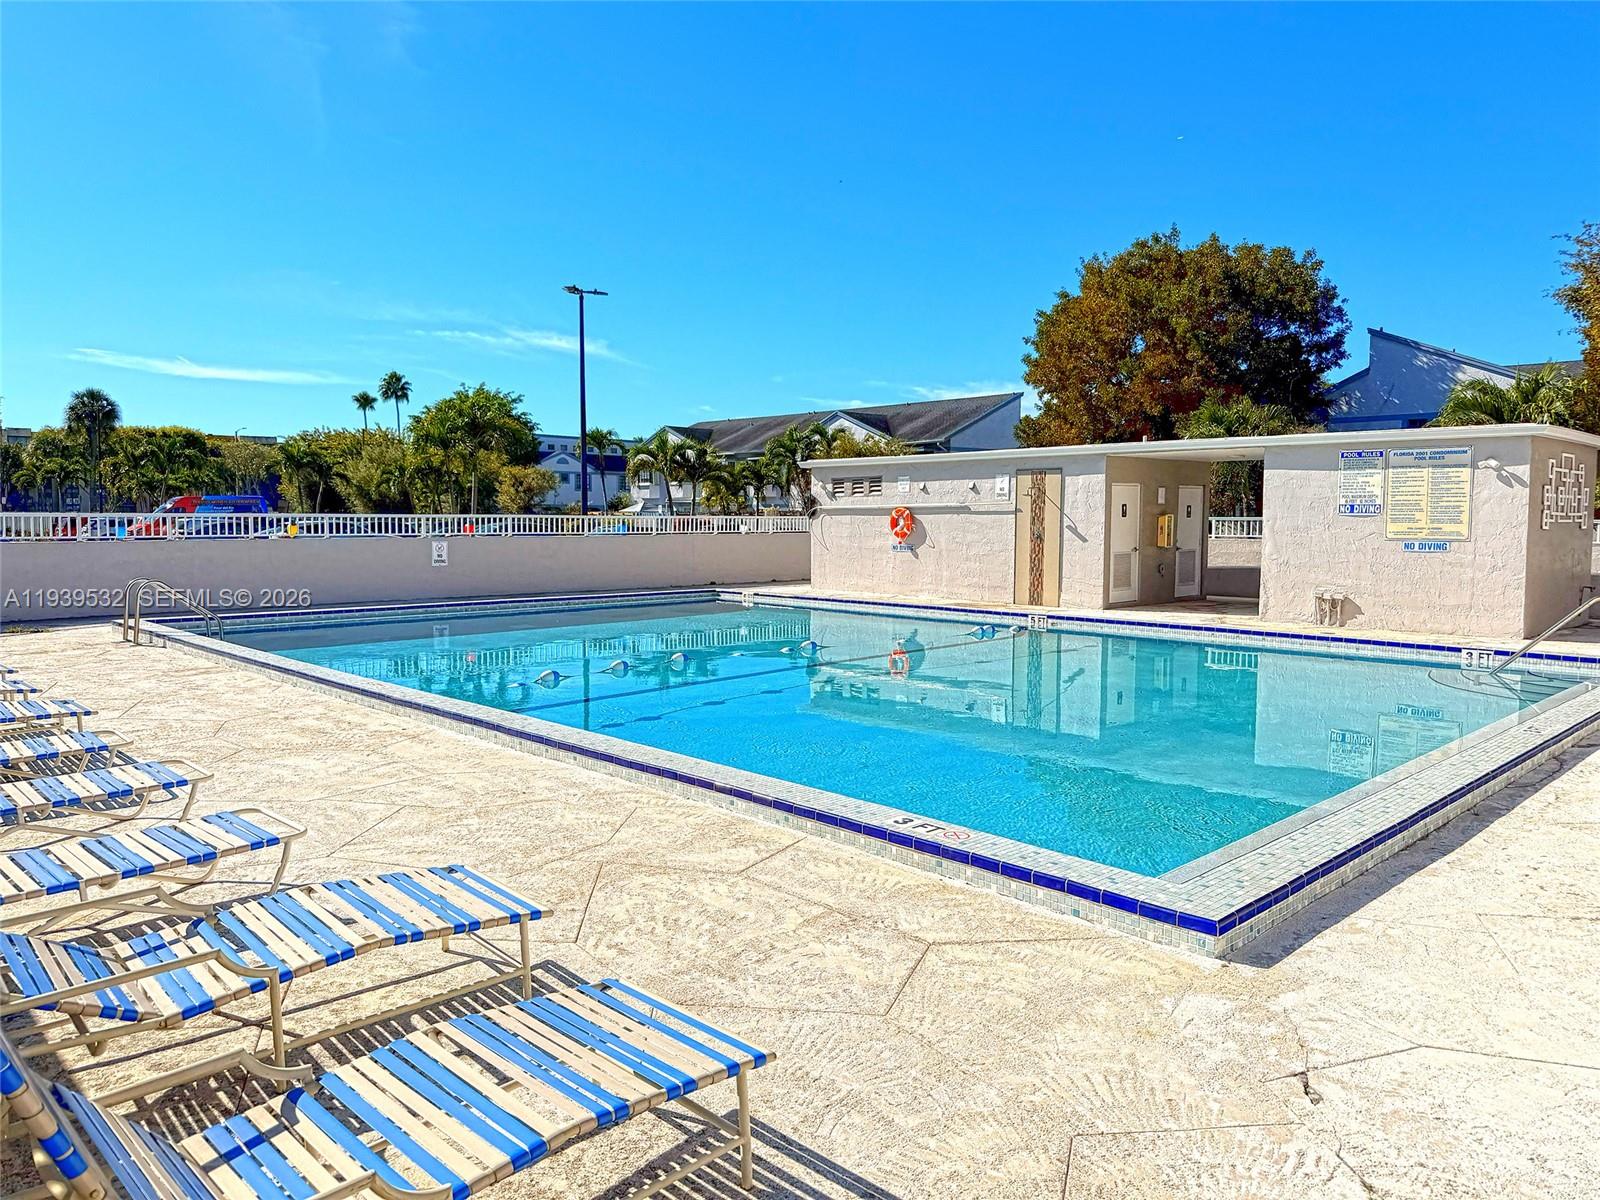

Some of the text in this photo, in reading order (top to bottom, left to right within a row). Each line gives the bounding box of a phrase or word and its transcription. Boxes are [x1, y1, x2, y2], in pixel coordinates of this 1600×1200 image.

[1340, 505, 1381, 513] NO DIVING
[1403, 542, 1448, 551] NO DIVING
